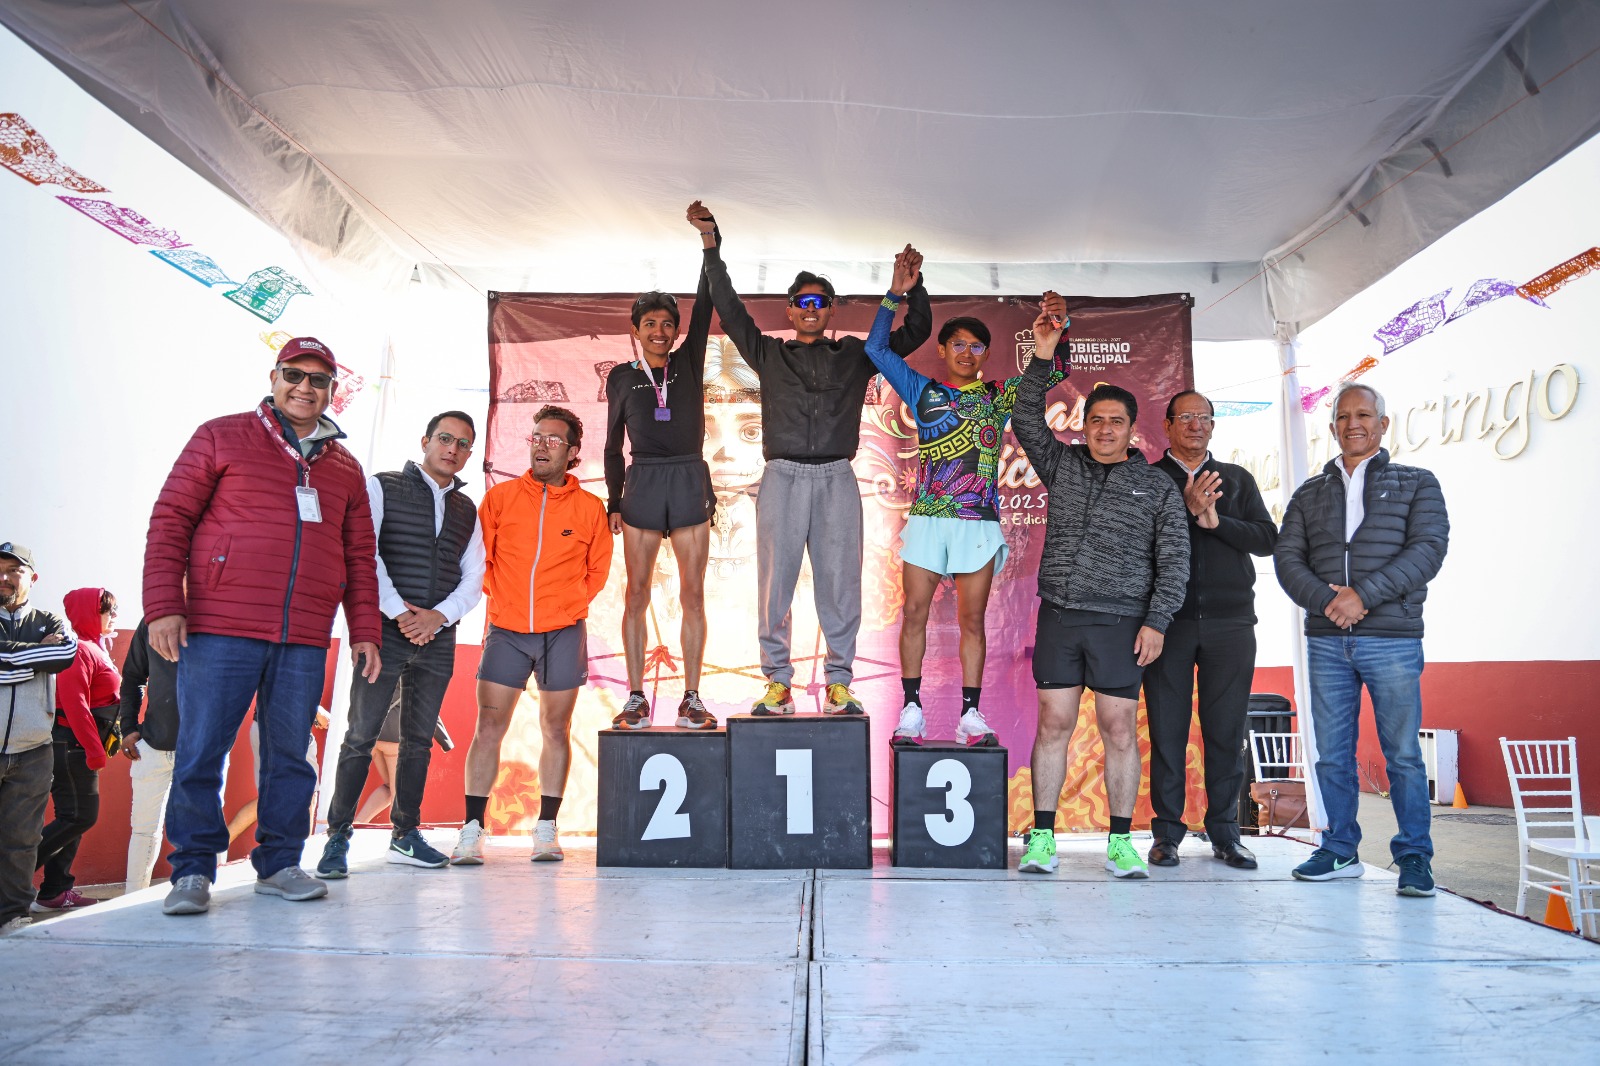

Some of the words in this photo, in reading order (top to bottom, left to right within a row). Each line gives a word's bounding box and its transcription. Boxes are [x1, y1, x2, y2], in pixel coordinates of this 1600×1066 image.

[1069, 342, 1131, 353] OBIERNO
[1070, 354, 1131, 364] UNICIPAL
[998, 492, 1049, 510] 2025
[1012, 512, 1048, 526] Edici
[639, 752, 692, 841] 2
[775, 748, 814, 835] 1
[923, 758, 975, 847] 3
